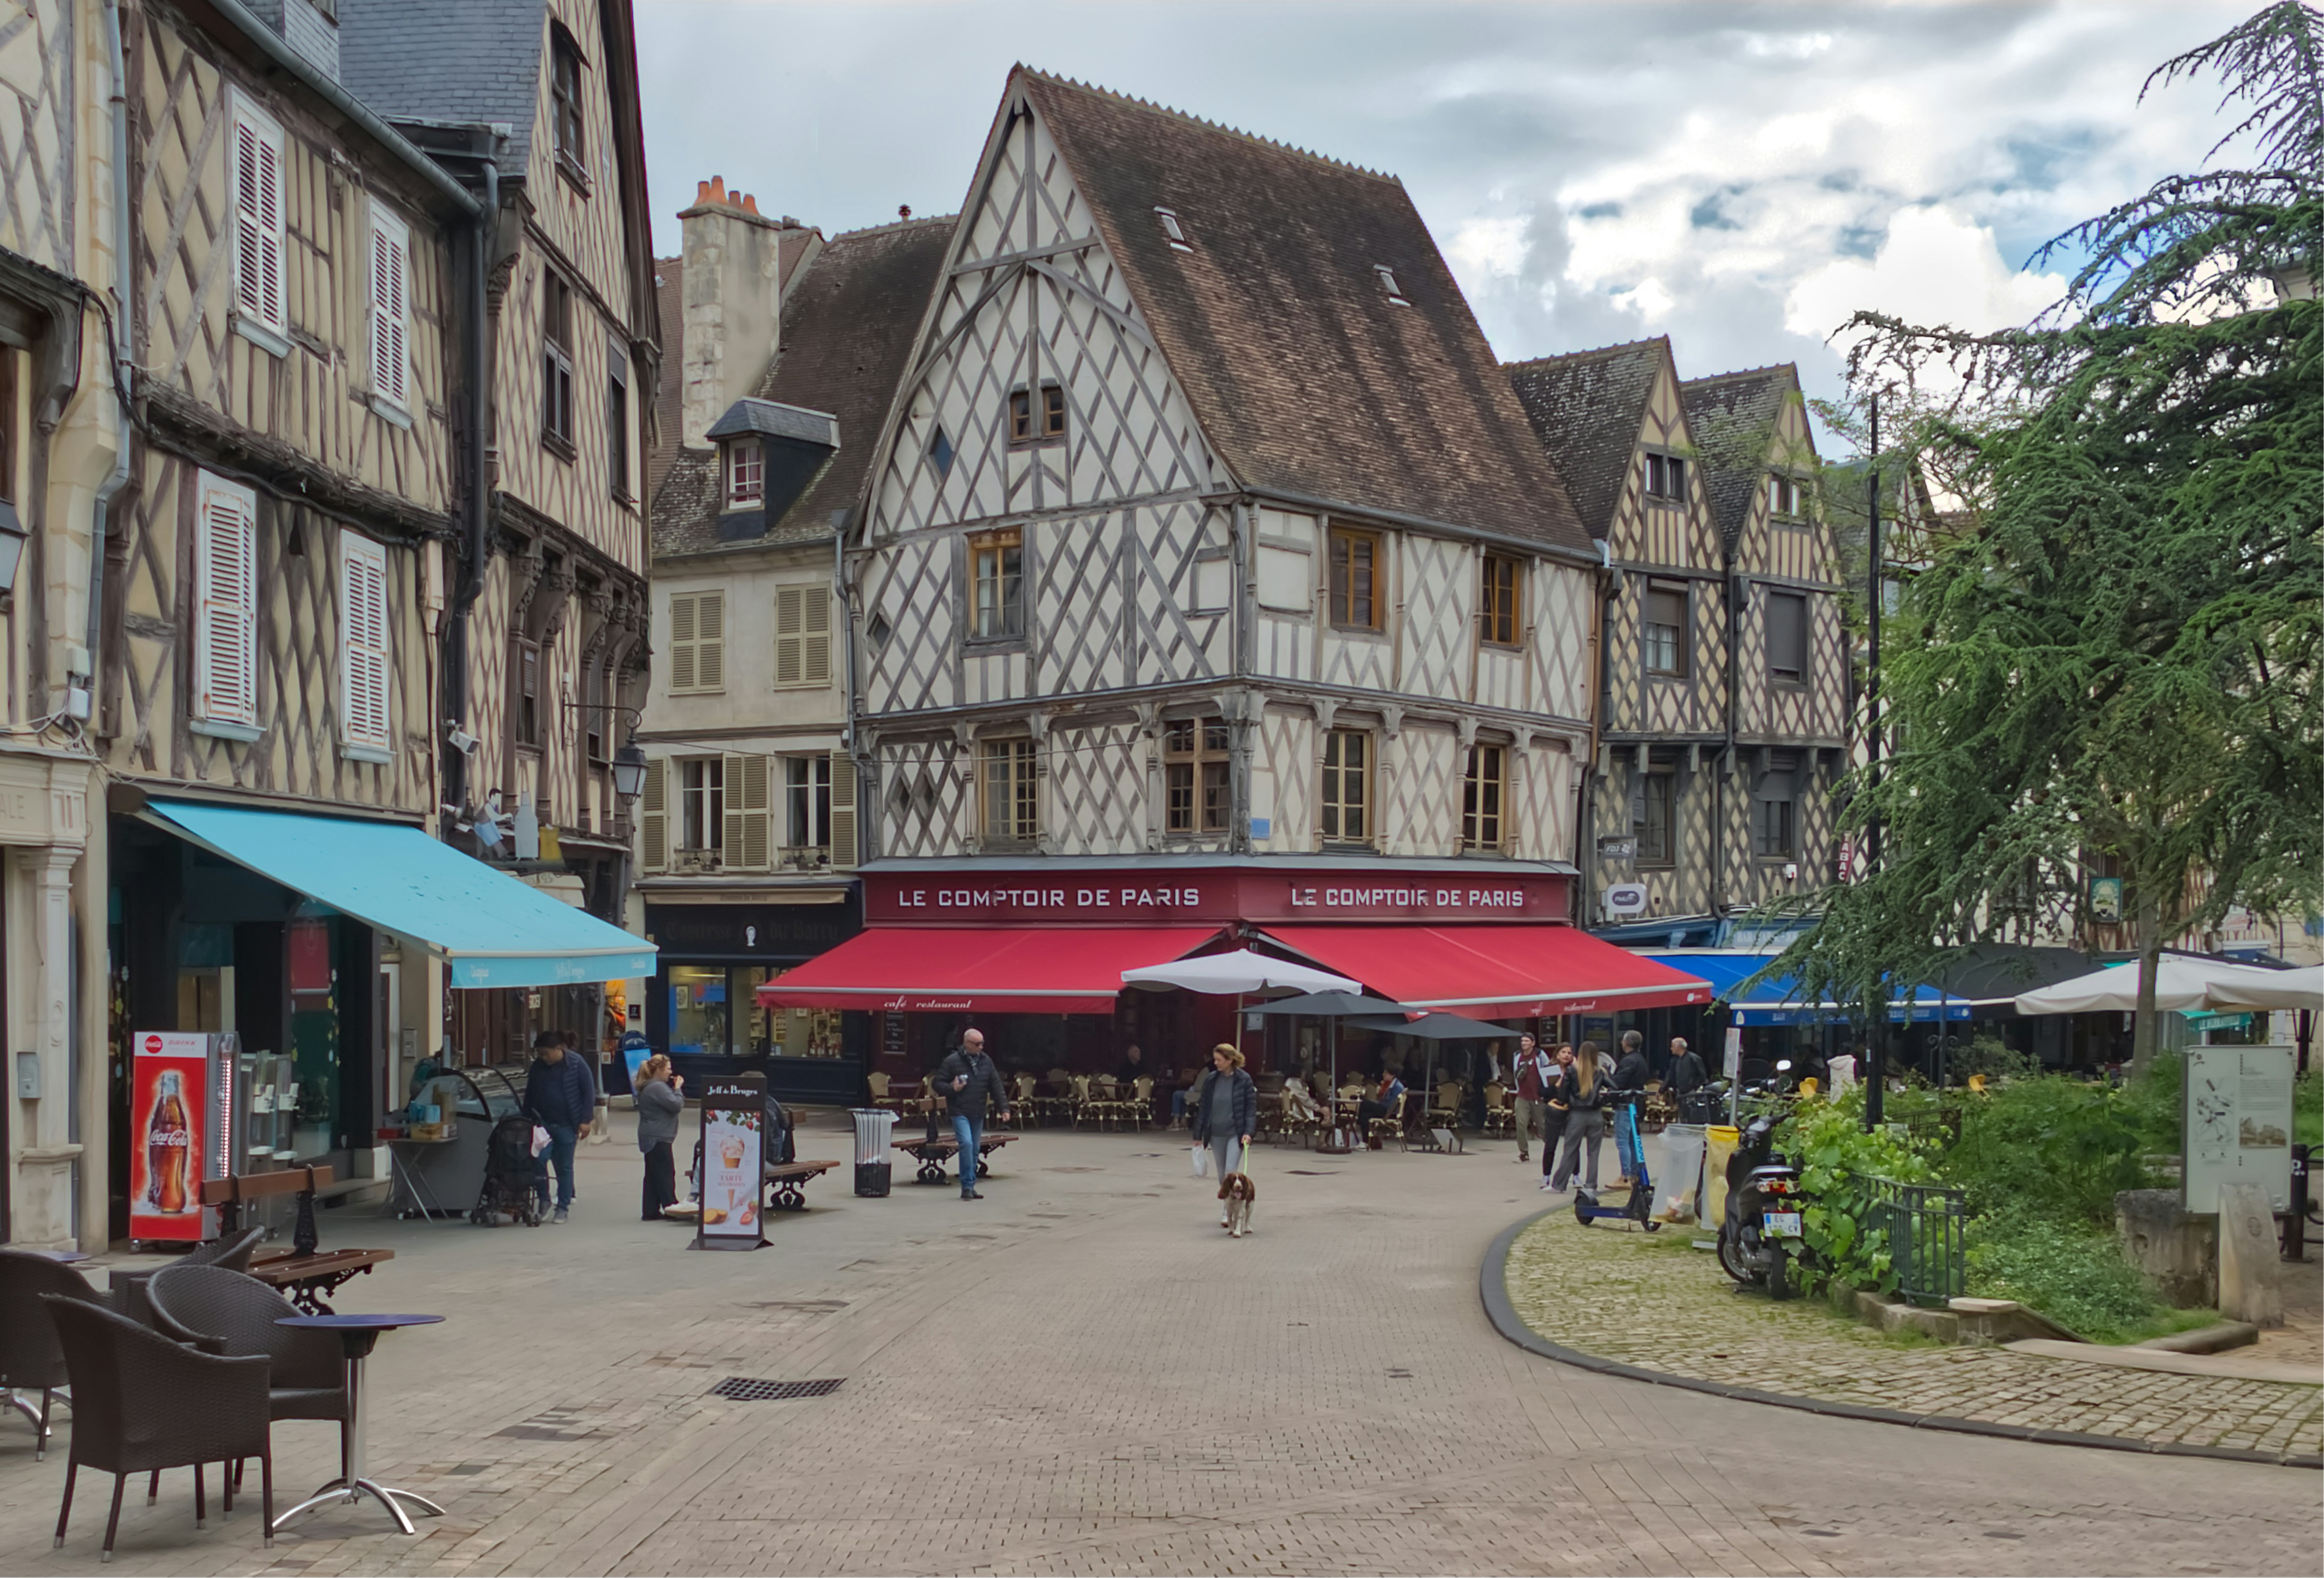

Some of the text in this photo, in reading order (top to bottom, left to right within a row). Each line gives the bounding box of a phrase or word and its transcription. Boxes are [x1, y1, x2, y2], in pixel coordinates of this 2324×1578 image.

[1838, 833, 1849, 880] TABAC
[899, 889, 1199, 906] LE COMPTOIR DE PARIS
[1291, 889, 1523, 907] LE COMPTOIR DE PARIS
[884, 995, 972, 1010] café restaurant
[707, 1086, 723, 1096] Jeff
[731, 1084, 758, 1097] Bruges
